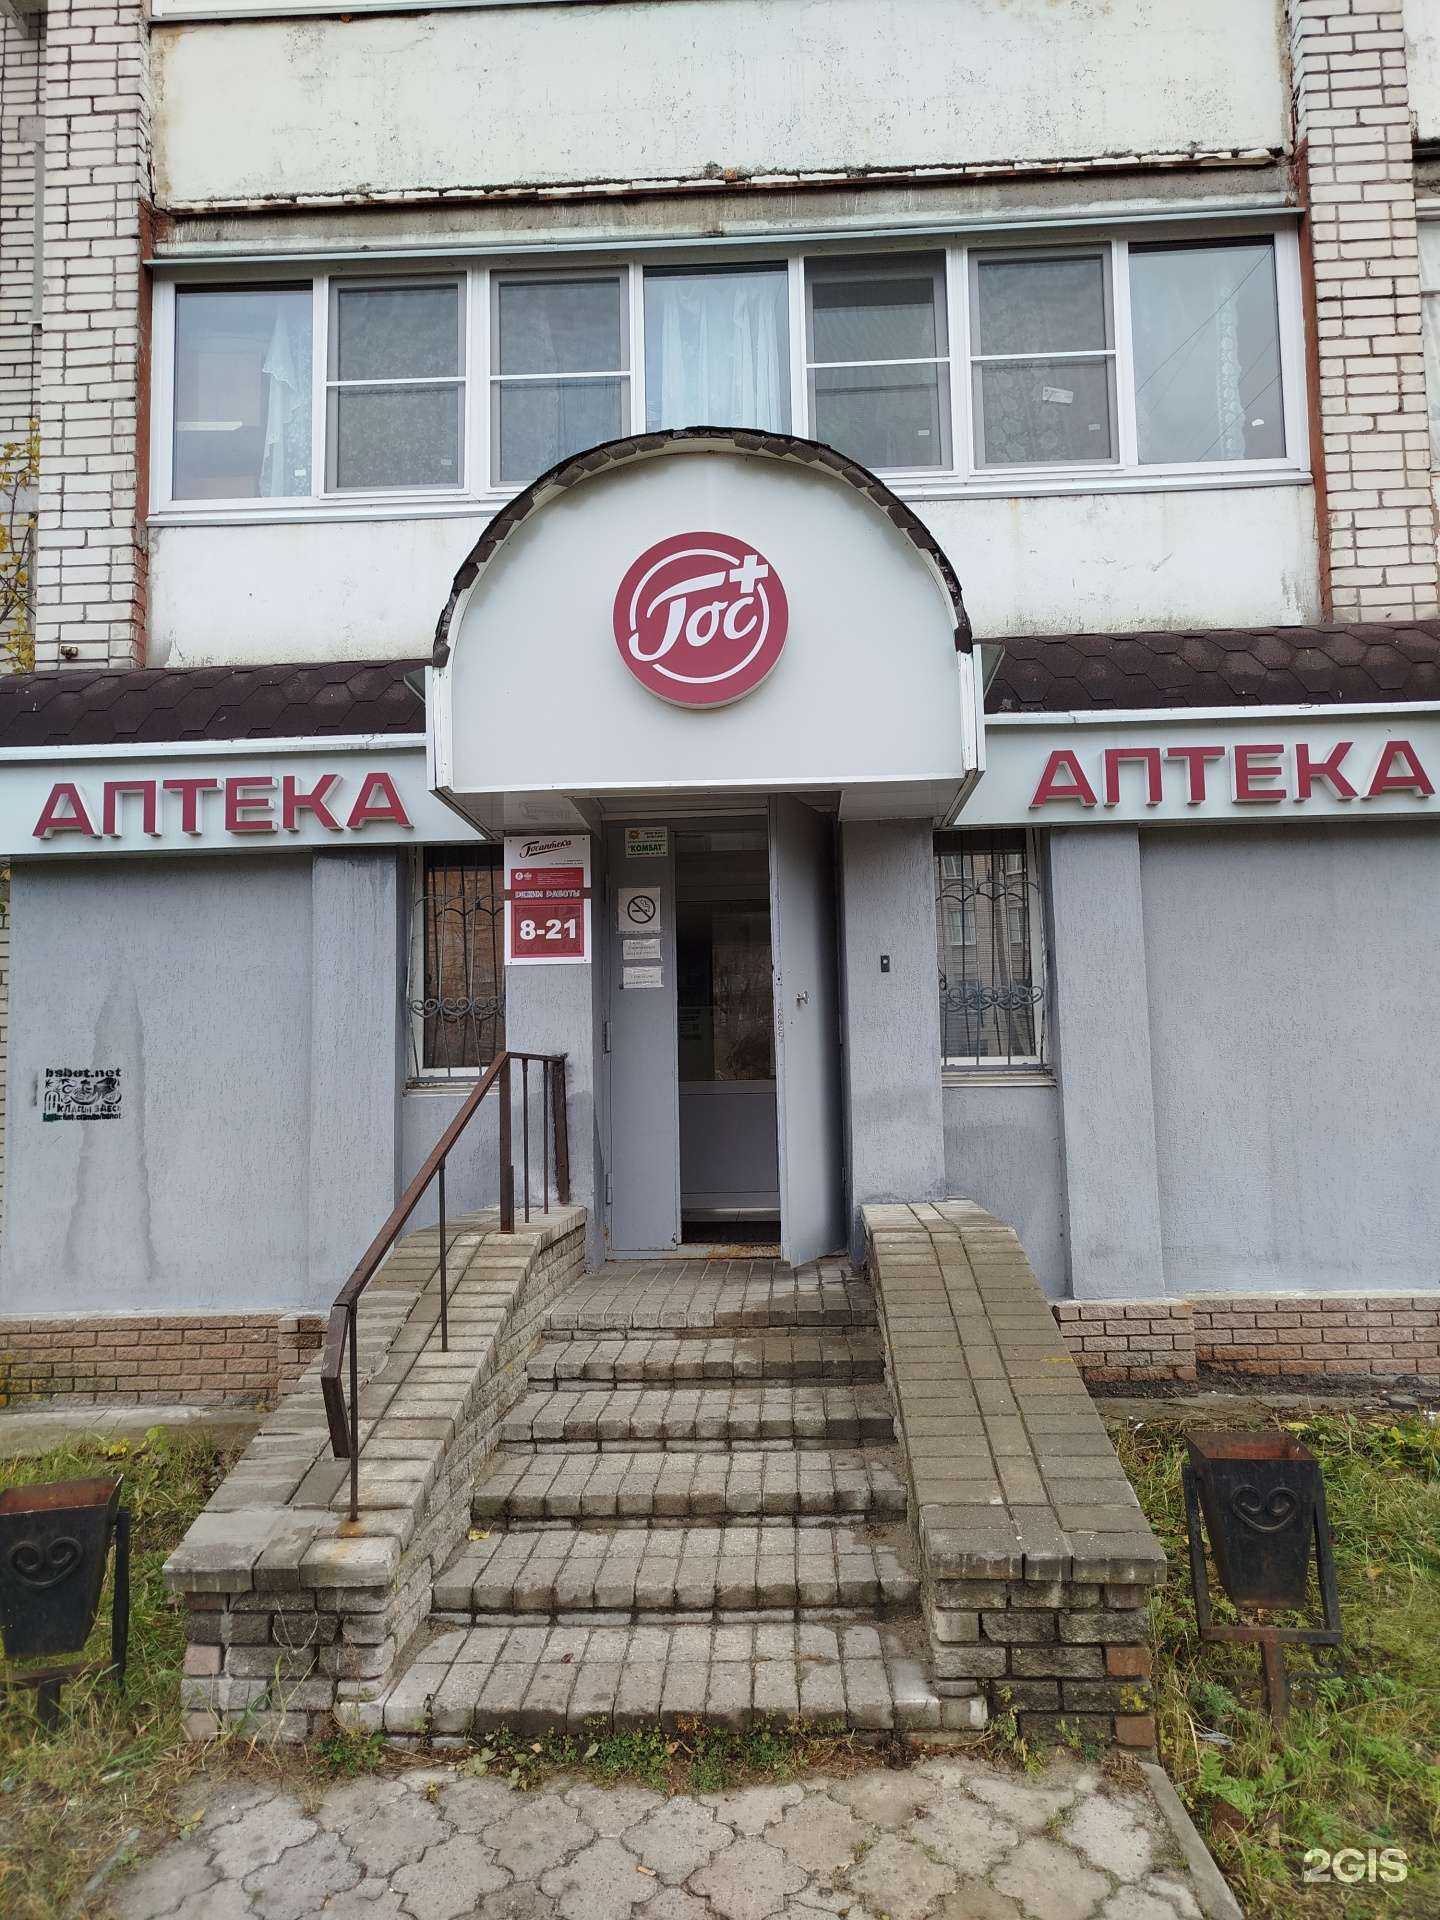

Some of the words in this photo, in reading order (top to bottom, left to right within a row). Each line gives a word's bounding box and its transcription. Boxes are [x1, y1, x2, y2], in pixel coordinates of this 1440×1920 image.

[32, 772, 415, 839] АПТЕКА
[1029, 740, 1436, 808] АПТЕКА
[520, 918, 576, 940] 8-21
